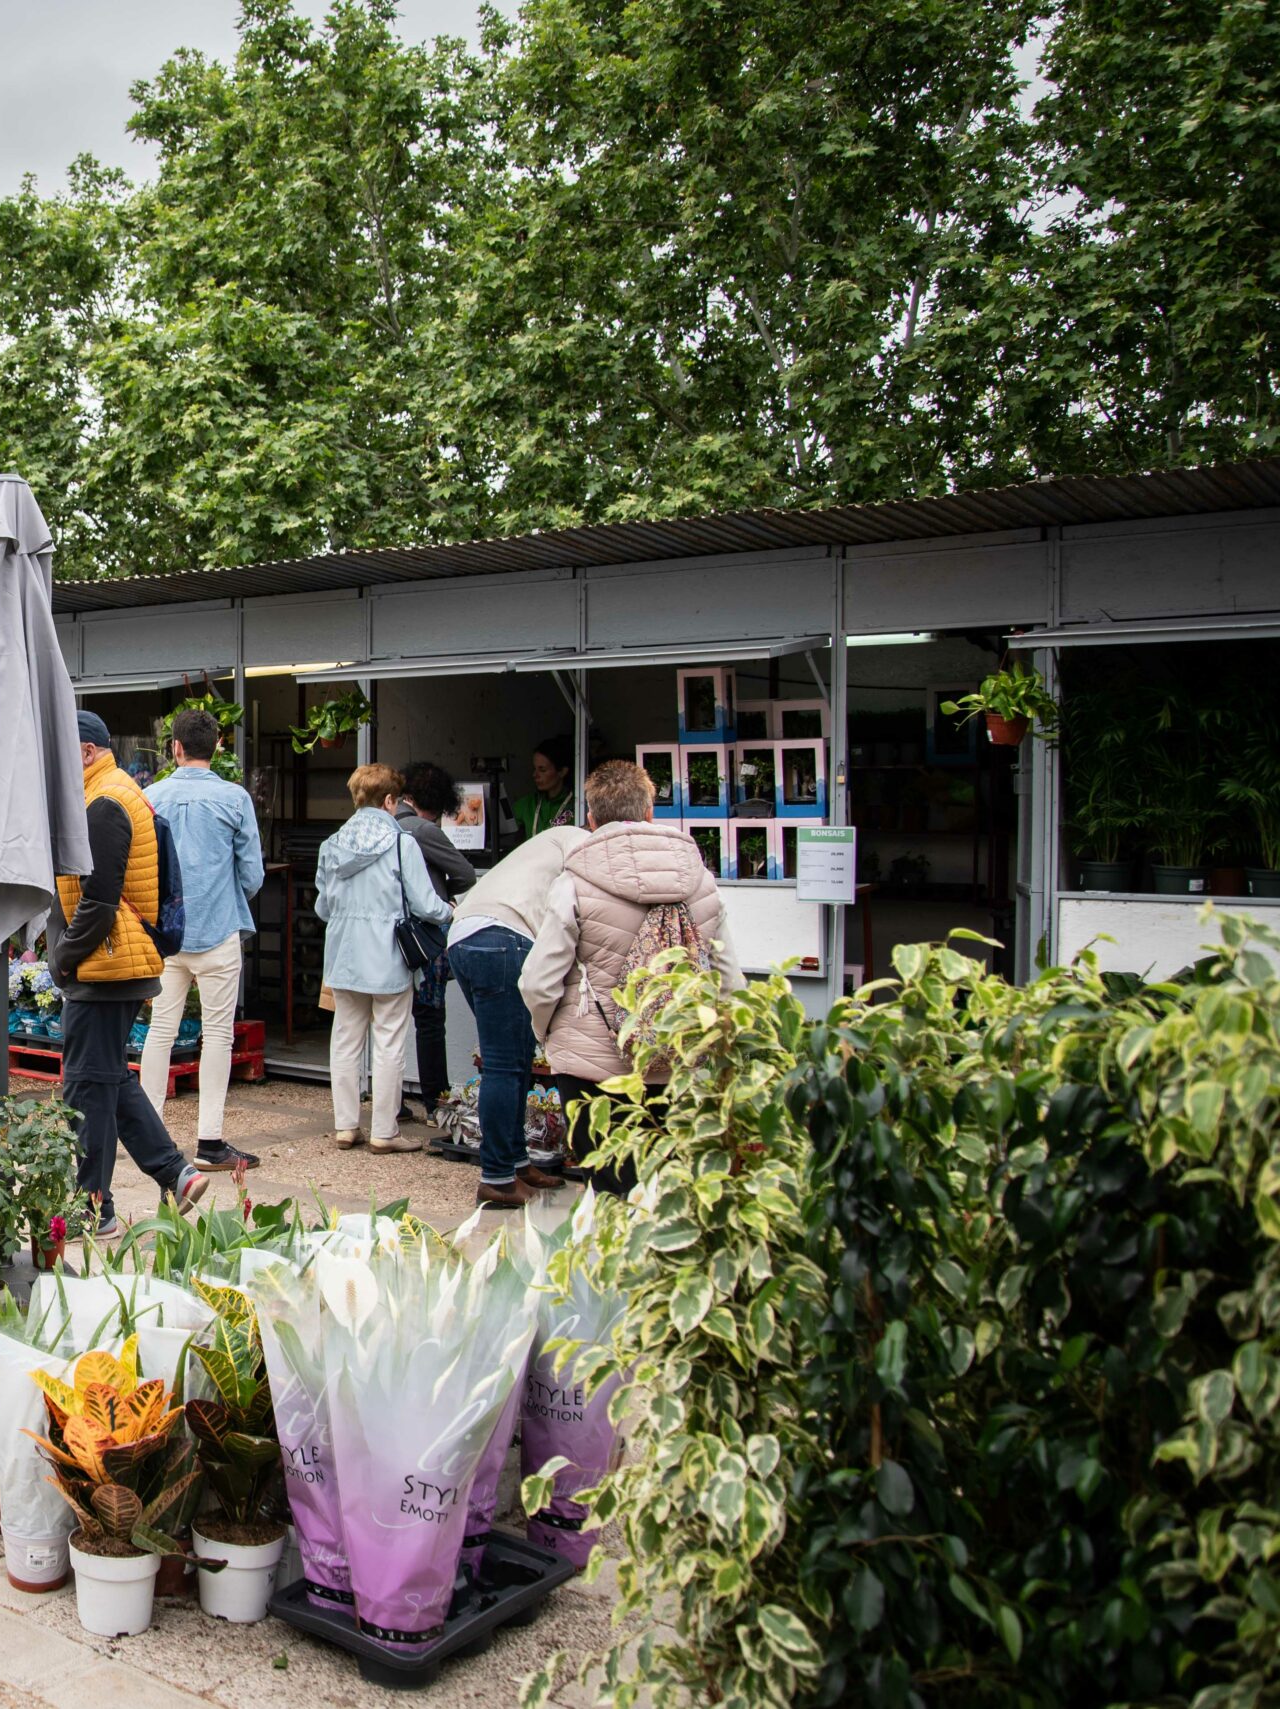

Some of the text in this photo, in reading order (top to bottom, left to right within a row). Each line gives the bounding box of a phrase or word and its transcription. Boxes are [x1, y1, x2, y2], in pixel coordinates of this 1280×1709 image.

[810, 829, 846, 837] BONSAIS
[527, 1375, 583, 1407] STYLE
[527, 1396, 583, 1422] EMOTION
[285, 1466, 324, 1484] OTION
